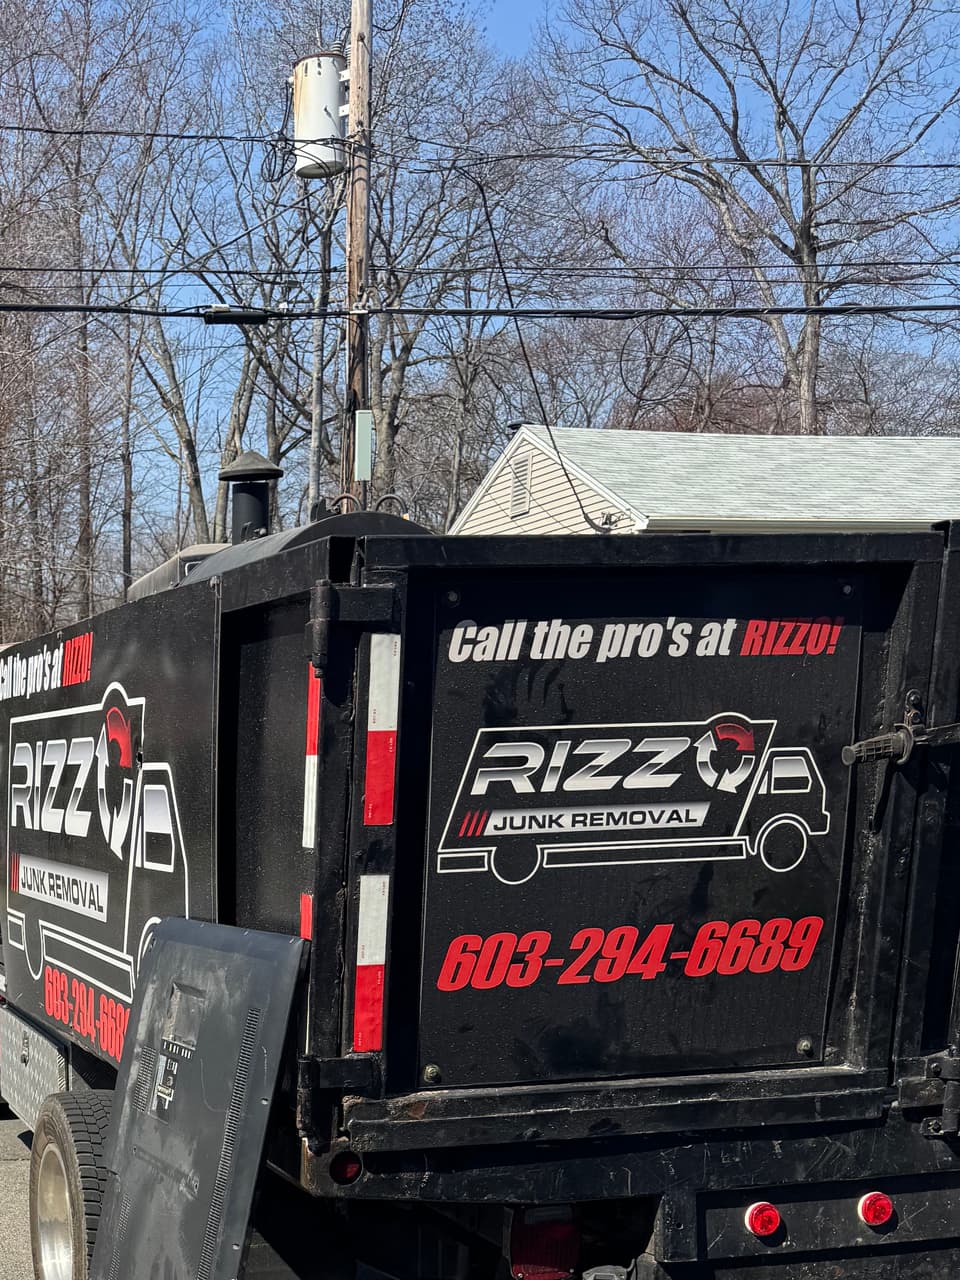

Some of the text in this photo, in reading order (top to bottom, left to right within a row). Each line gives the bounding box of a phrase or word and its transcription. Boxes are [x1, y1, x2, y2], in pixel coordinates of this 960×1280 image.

[448, 616, 844, 663] Call the pro's at RIZZO!
[0, 632, 93, 701] Call the pro's at RIZZO!
[493, 808, 698, 831] JUNK REMOVAL
[21, 865, 104, 913] JUNK REMOVAL
[437, 916, 824, 992] 603-294-6689
